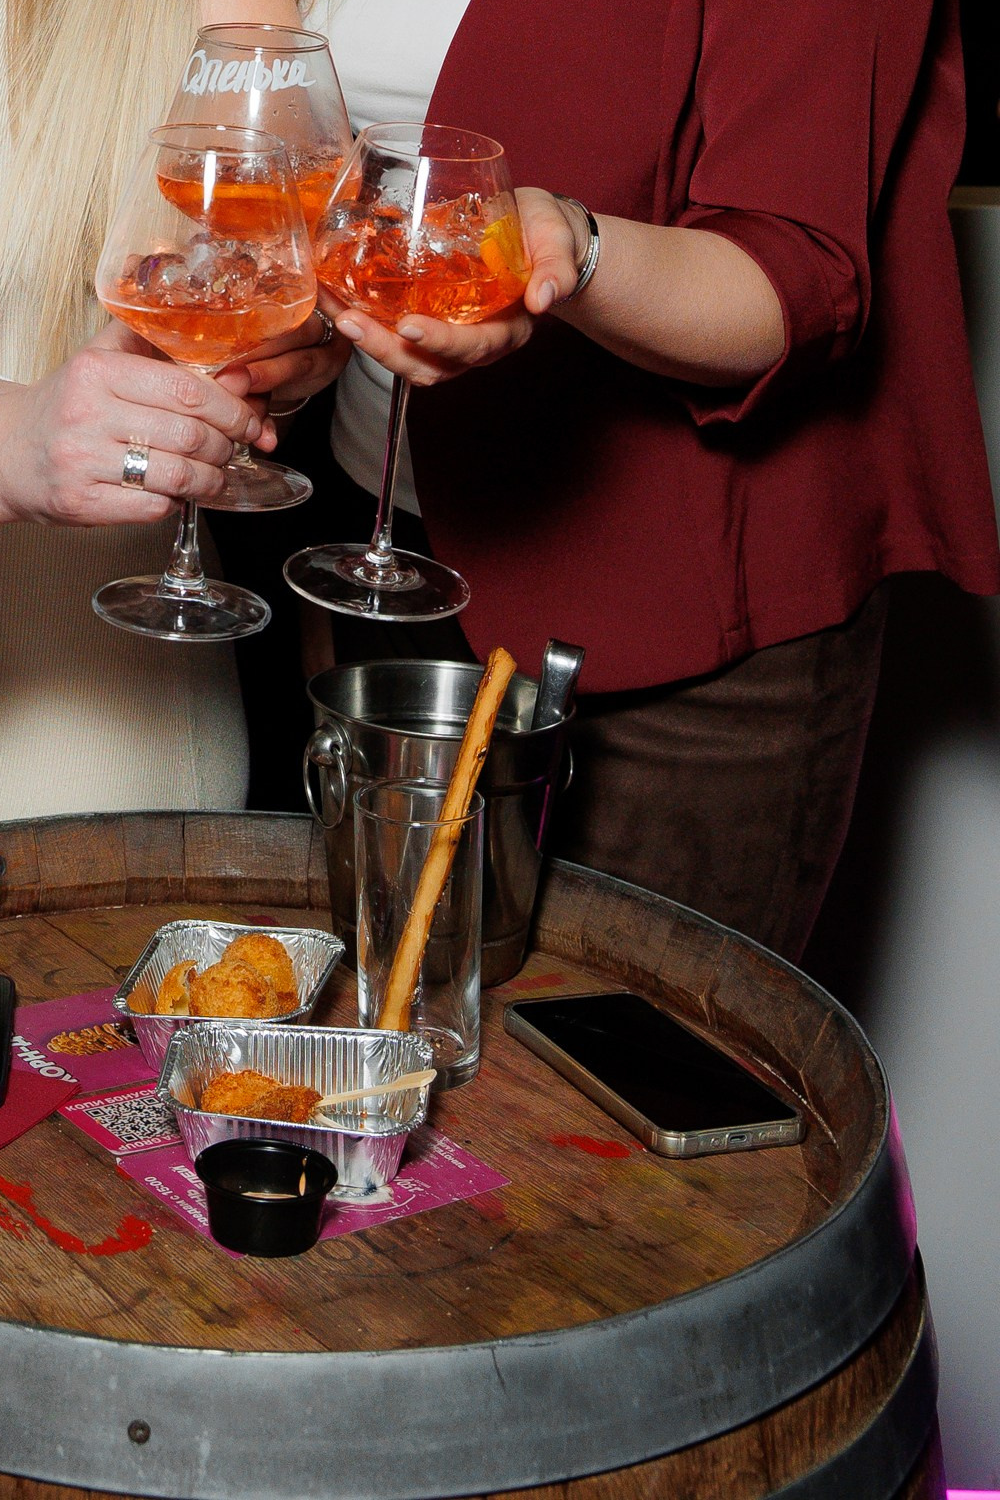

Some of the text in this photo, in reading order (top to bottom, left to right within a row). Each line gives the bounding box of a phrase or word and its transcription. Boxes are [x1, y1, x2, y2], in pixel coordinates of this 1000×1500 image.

[65, 1099, 104, 1112] КОПИ
[119, 1138, 162, 1151] GROUP
[144, 1176, 173, 1196] 15:00
